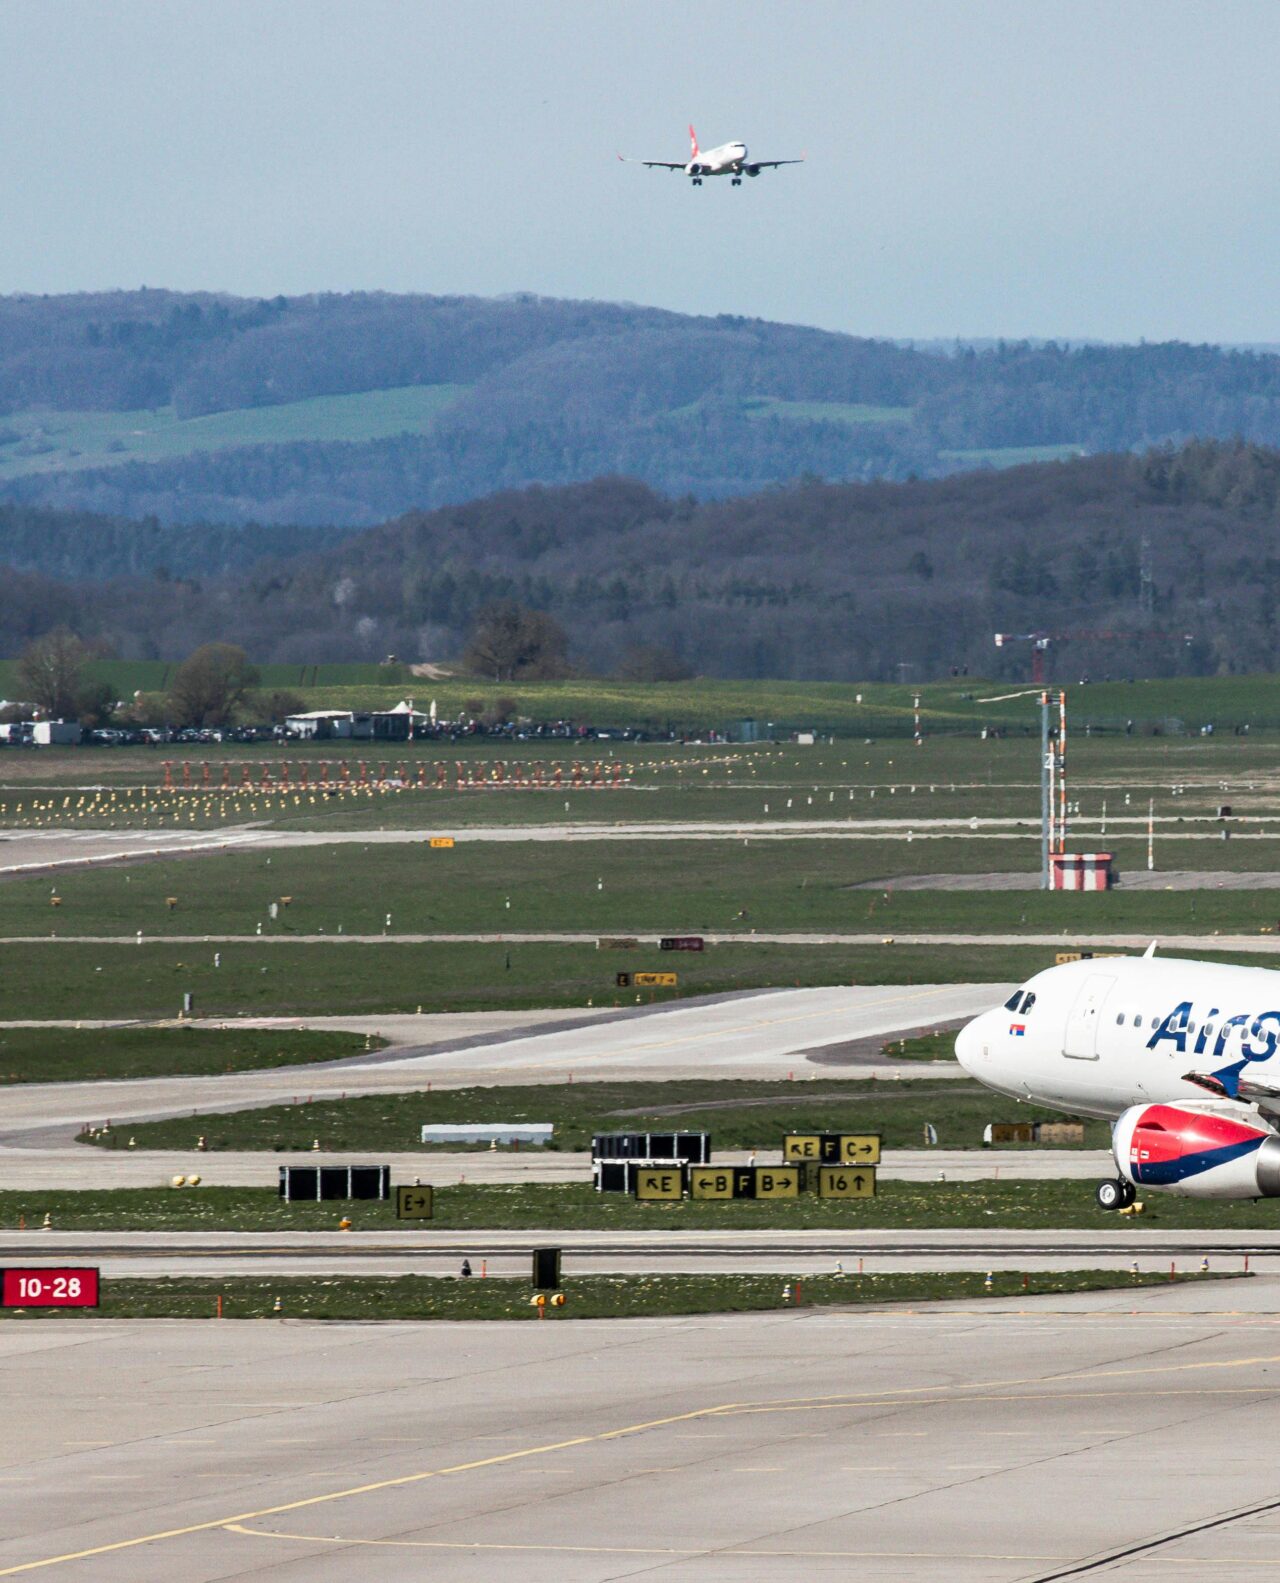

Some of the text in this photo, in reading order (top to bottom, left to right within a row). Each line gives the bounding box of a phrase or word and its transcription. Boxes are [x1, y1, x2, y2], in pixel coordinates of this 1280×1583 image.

[804, 1142, 857, 1157] E F C
[661, 1176, 672, 1192] E
[715, 1175, 773, 1192] B F B
[828, 1175, 847, 1191] 16
[404, 1194, 413, 1211] E
[18, 1277, 81, 1298] 10-28
